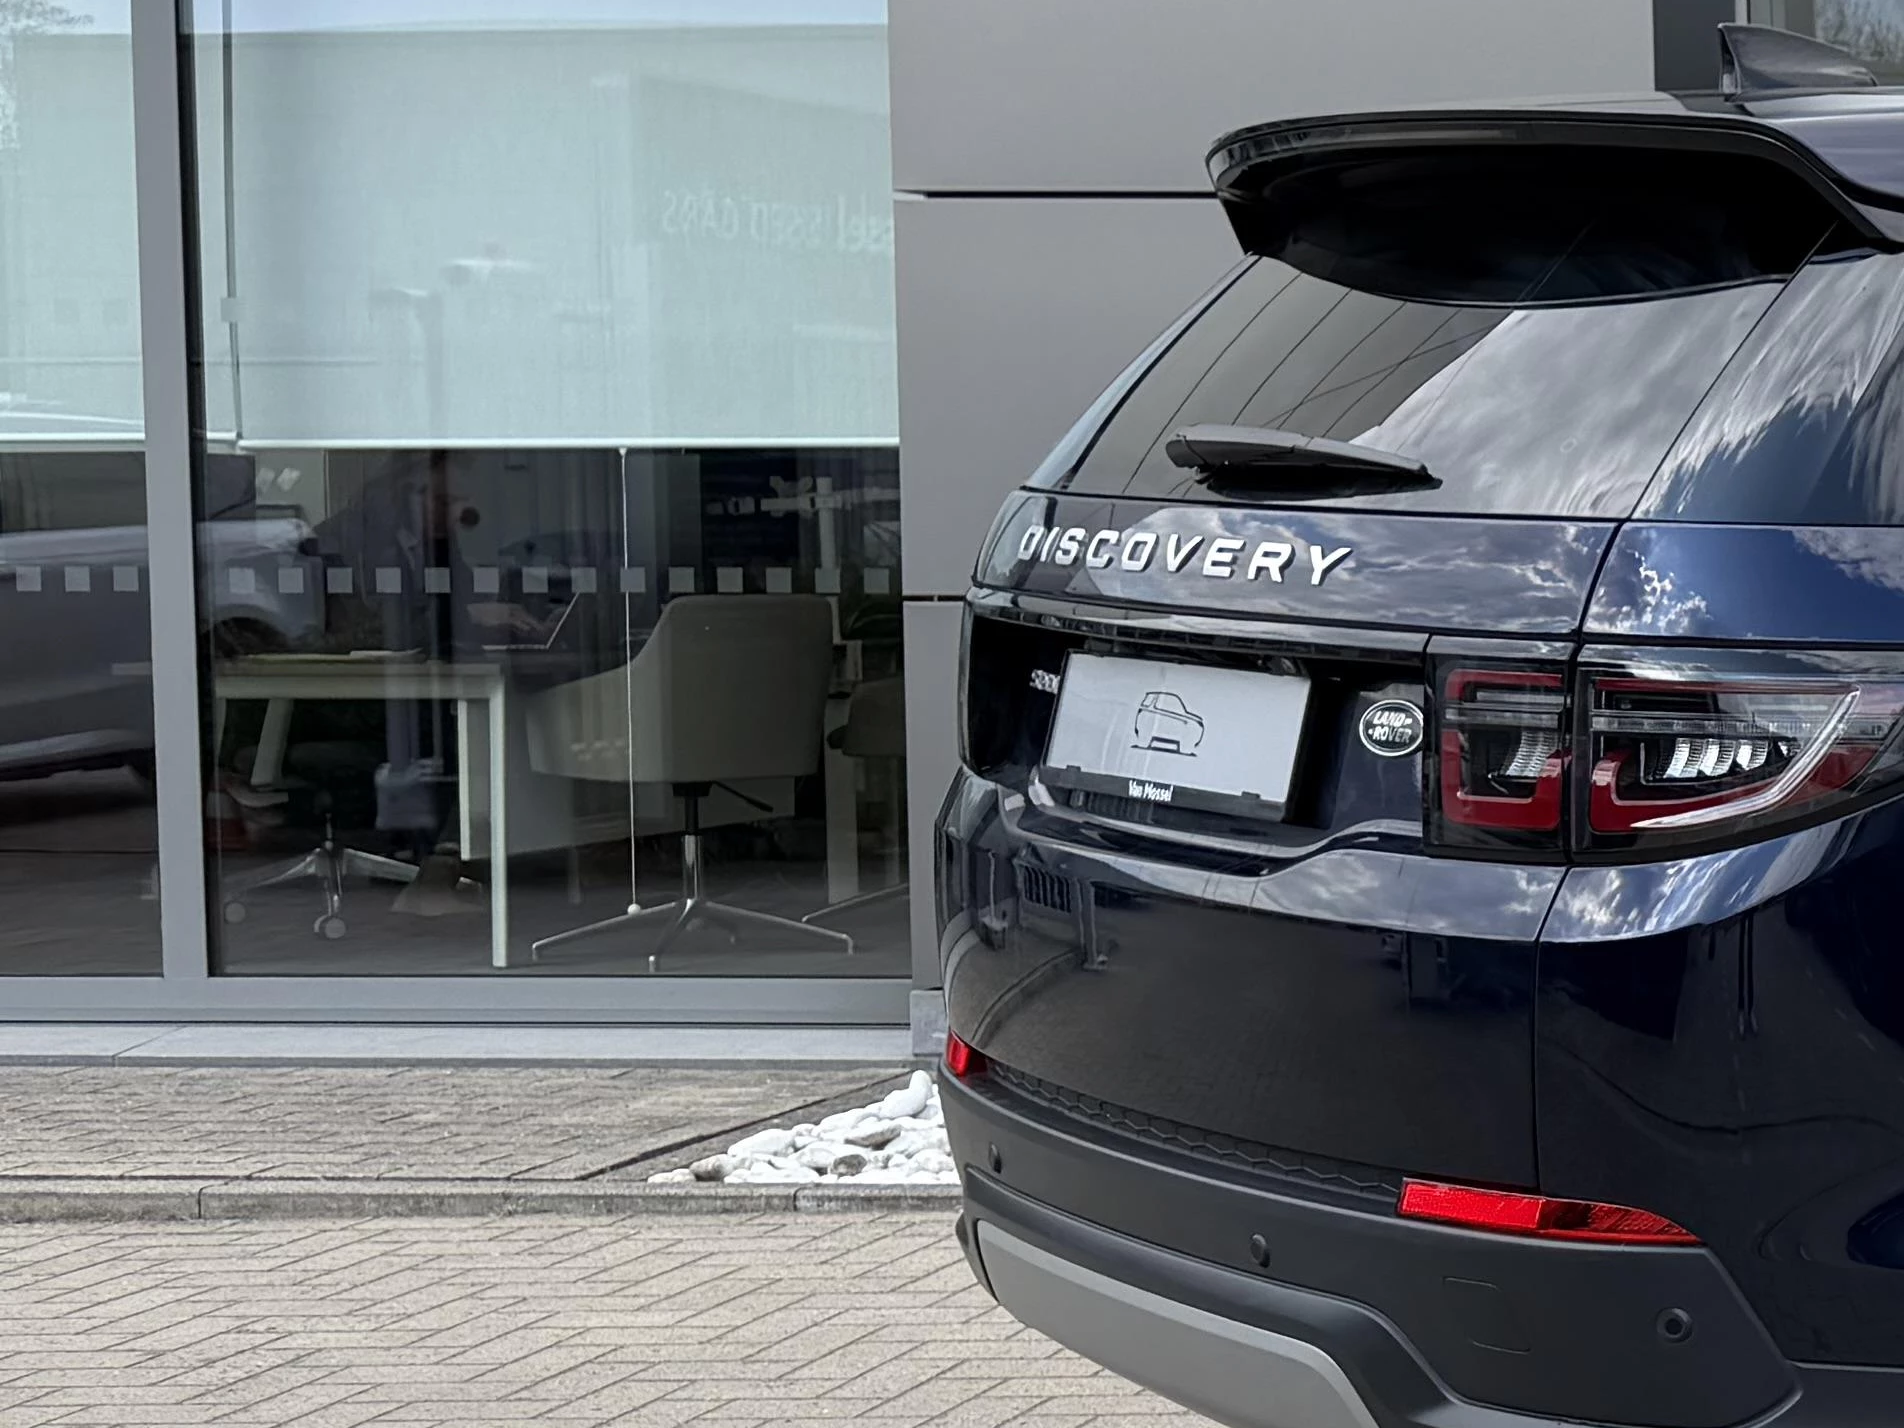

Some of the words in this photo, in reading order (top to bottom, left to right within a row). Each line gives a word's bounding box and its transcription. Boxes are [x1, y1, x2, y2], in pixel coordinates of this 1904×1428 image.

[1018, 524, 1352, 586] DISCOVERY
[1373, 710, 1406, 727] LAND
[1373, 725, 1412, 743] ROVER
